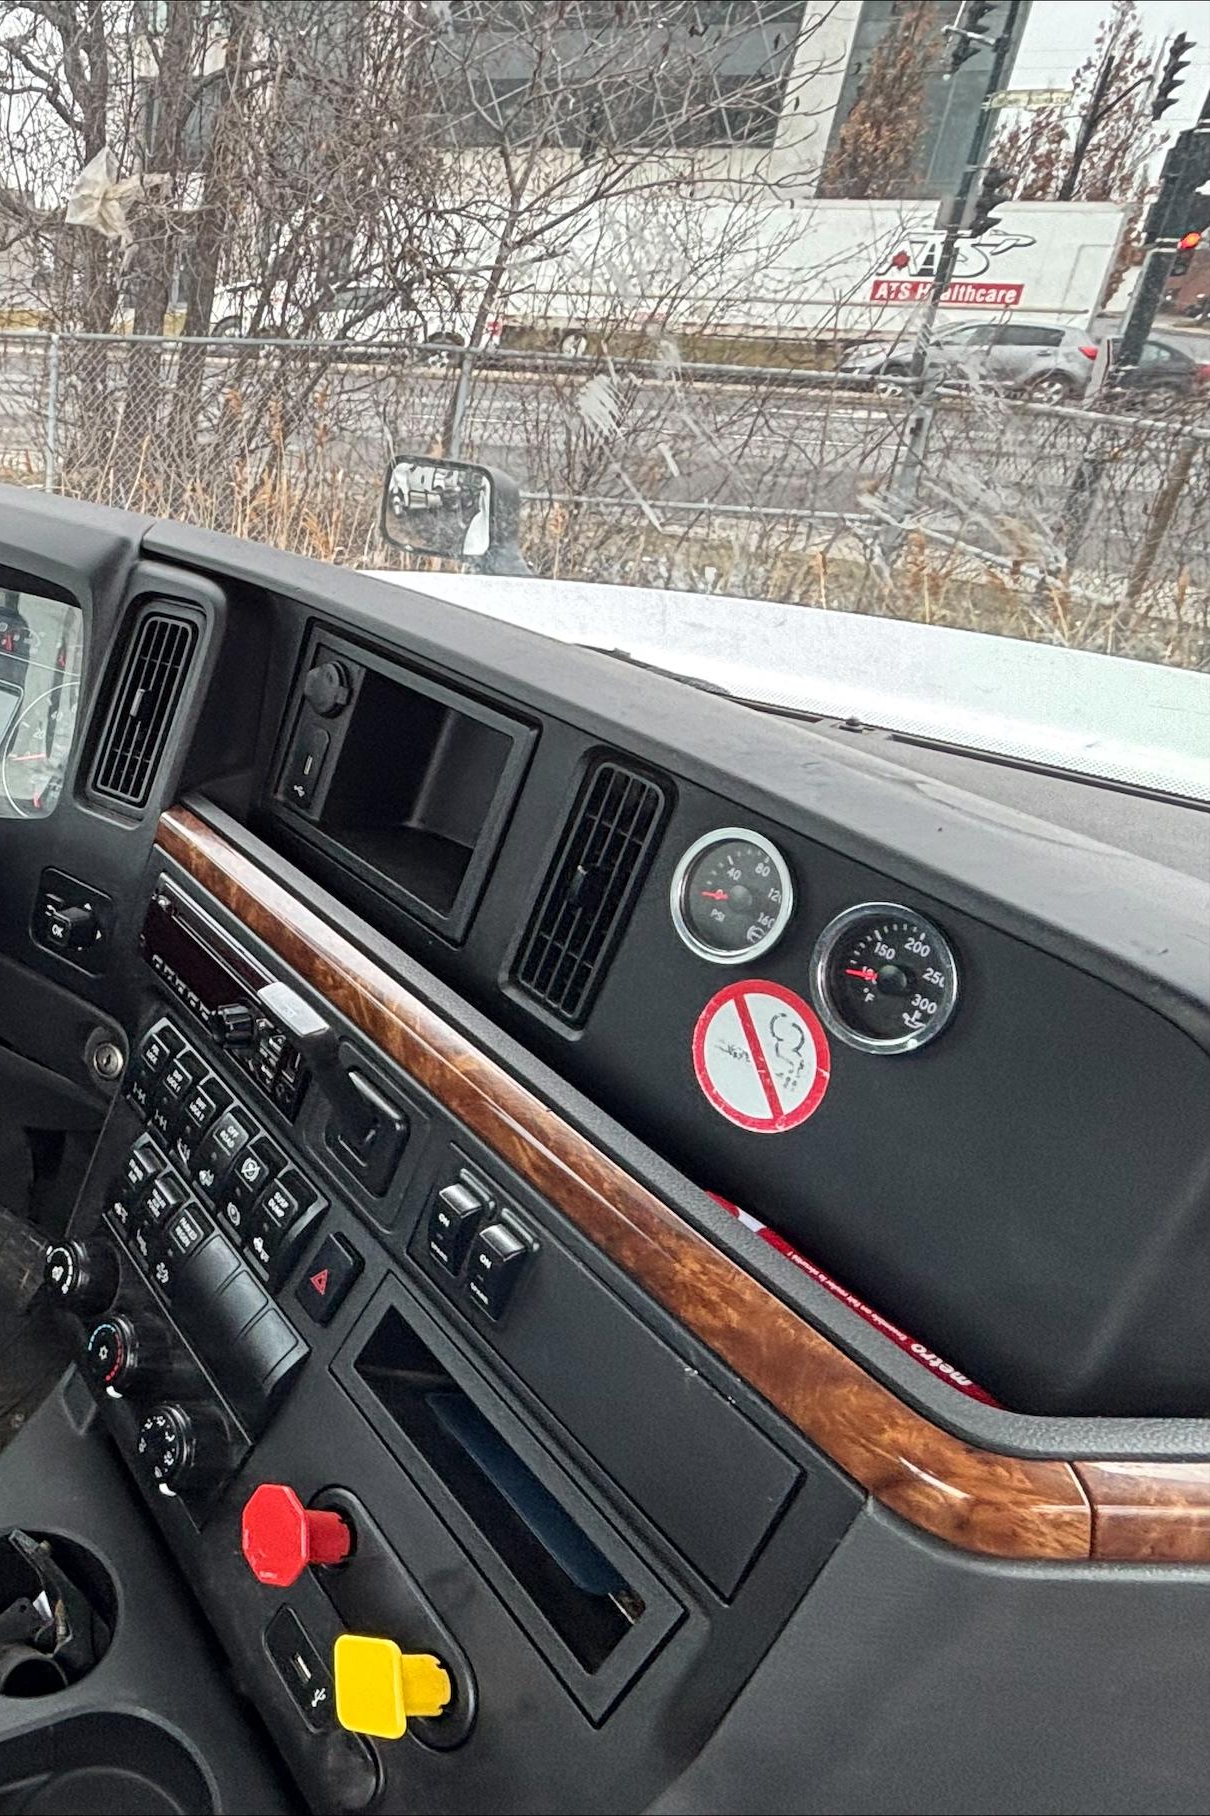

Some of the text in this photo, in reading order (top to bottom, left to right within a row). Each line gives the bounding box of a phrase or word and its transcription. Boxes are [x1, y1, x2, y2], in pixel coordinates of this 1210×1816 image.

[875, 282, 1018, 304] ATS Halthcare
[727, 867, 742, 881] 40
[755, 862, 770, 877] 80
[710, 908, 726, 923] PSI
[874, 942, 896, 960] 150
[904, 937, 930, 957] 200
[911, 993, 938, 1014] 300
[220, 1130, 235, 1148] ROAD
[227, 1125, 239, 1138] OFF
[910, 1343, 974, 1387] metro
